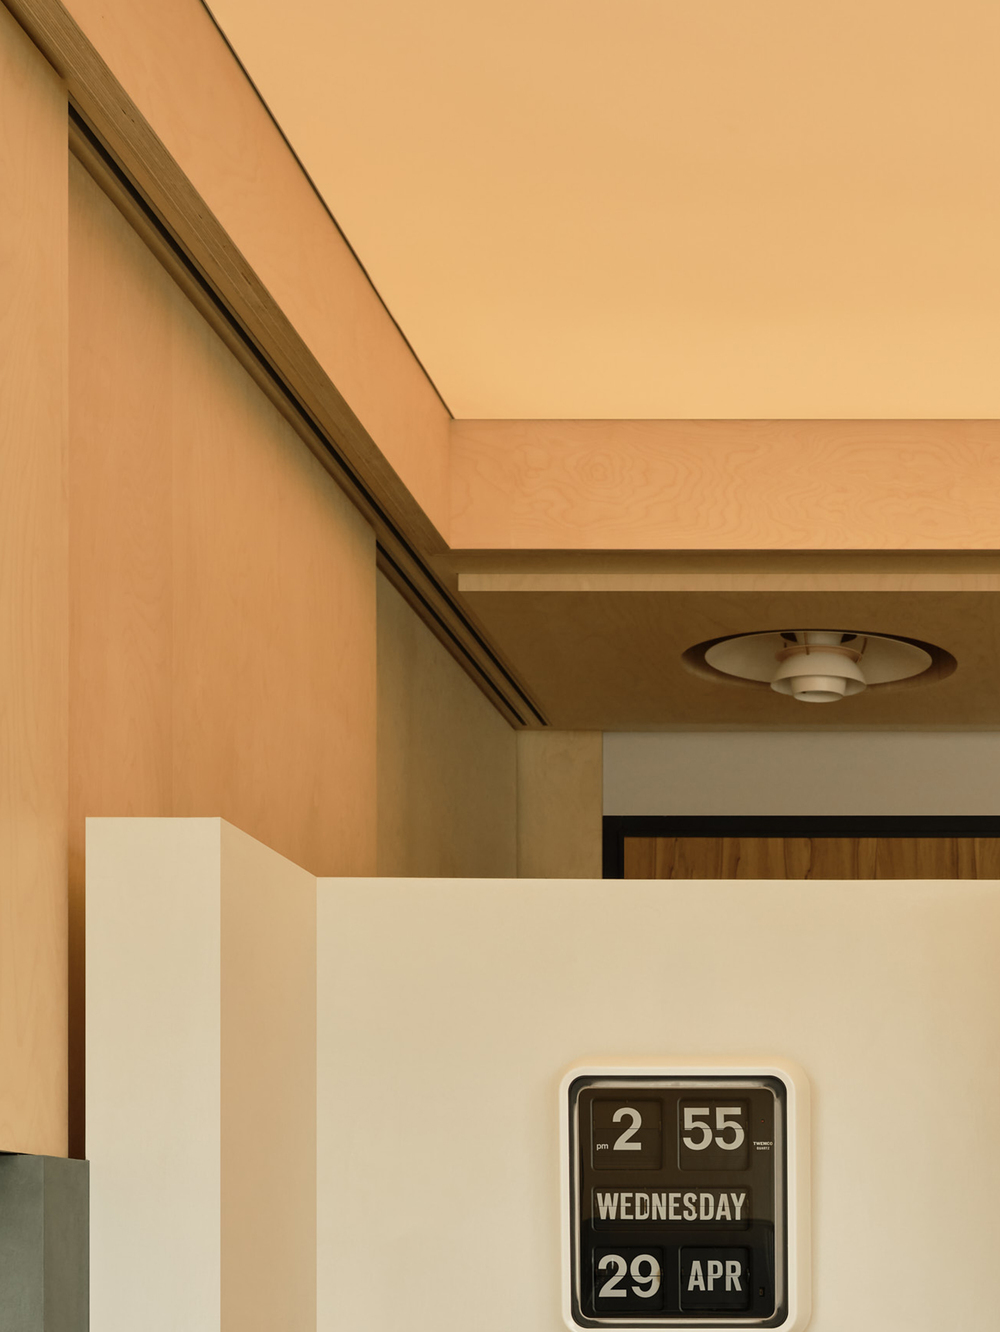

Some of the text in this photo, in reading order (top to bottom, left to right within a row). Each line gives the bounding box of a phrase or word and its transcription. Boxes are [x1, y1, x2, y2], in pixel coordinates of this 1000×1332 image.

[596, 1107, 745, 1151] pm 2 55
[597, 1193, 746, 1221] WEDNESDAY
[598, 1254, 742, 1298] 29 APR
